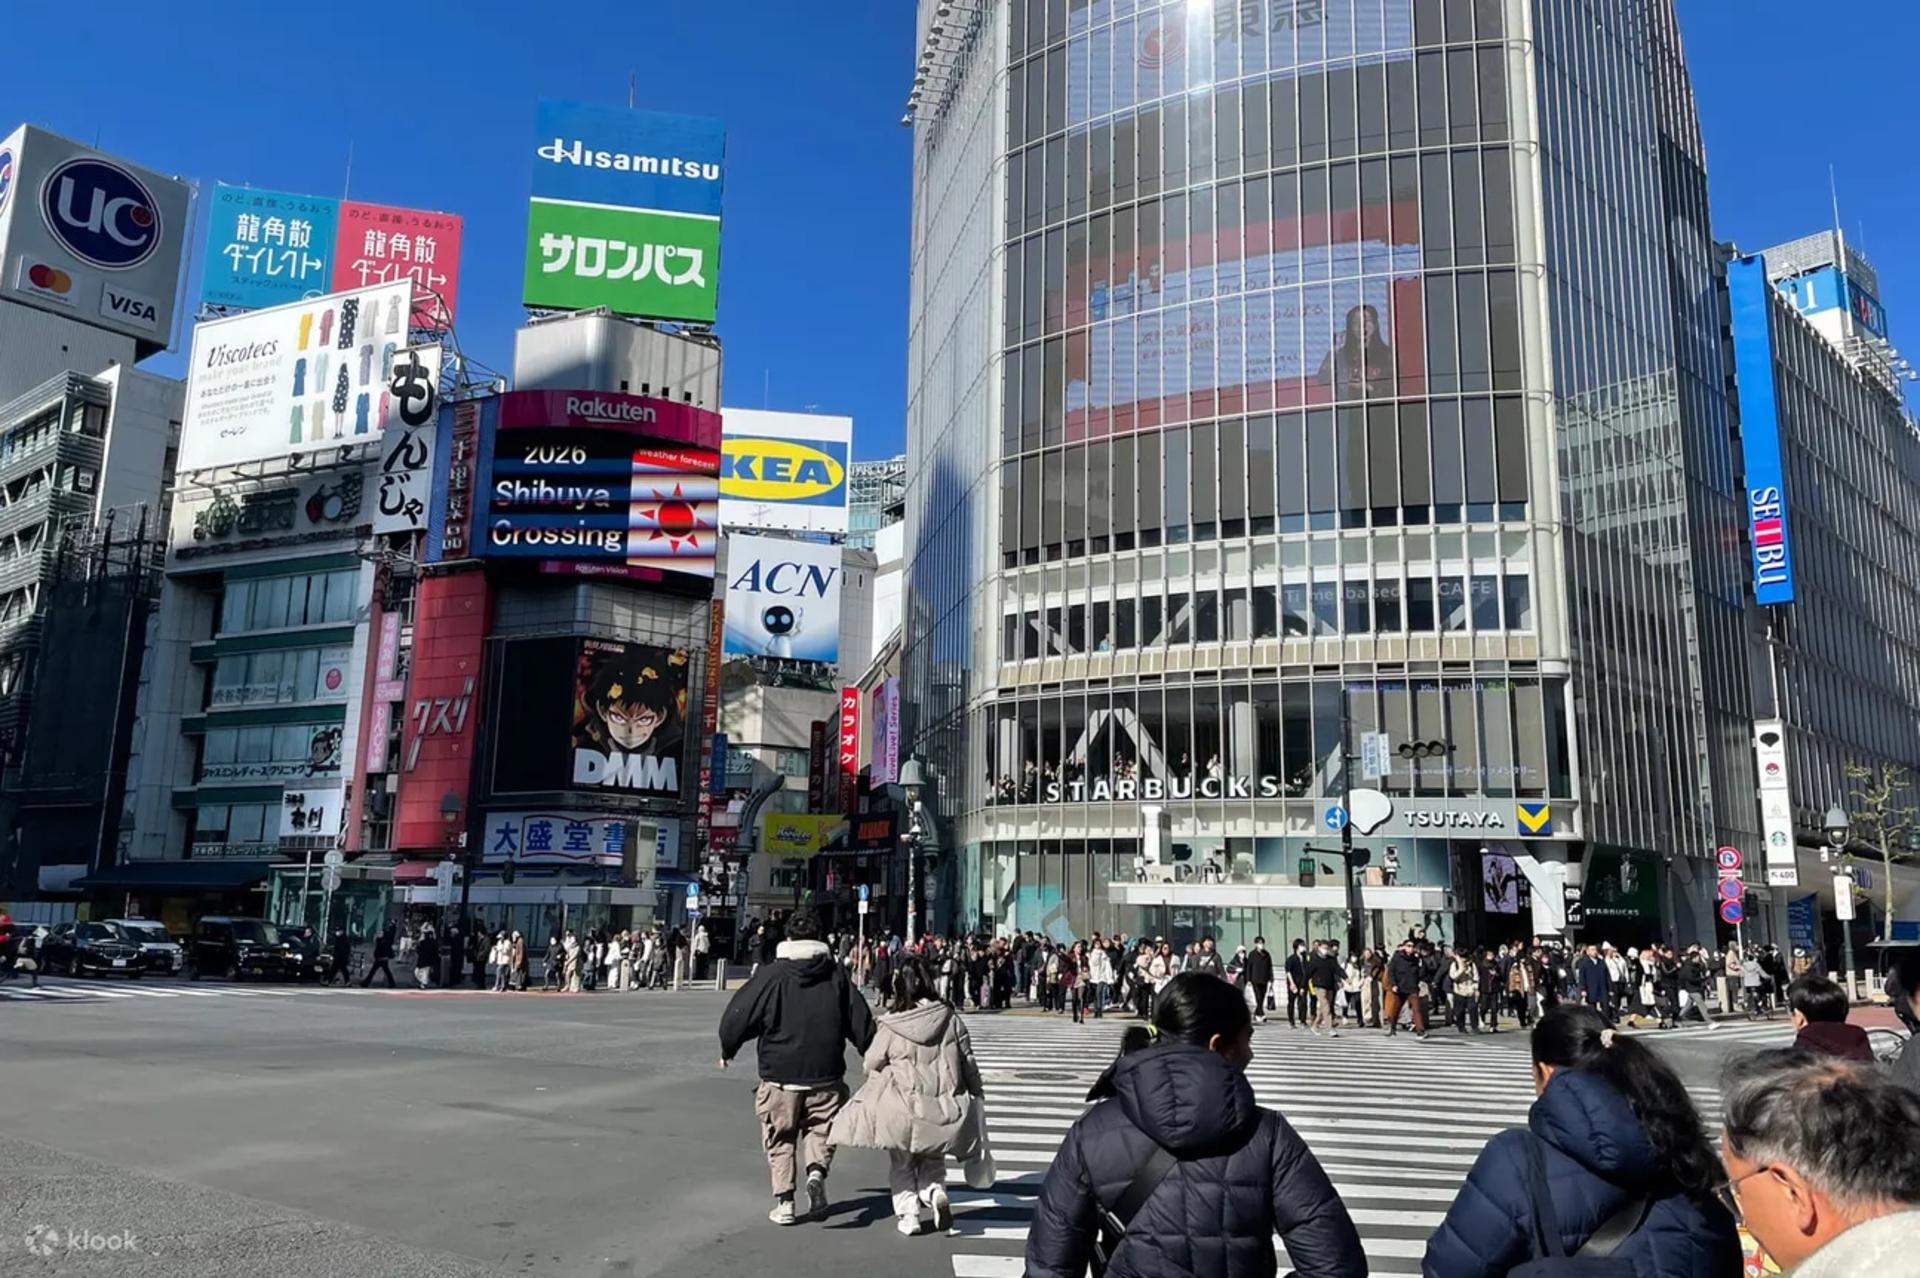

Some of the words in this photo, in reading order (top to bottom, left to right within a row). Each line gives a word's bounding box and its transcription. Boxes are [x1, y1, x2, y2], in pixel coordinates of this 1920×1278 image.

[537, 138, 719, 180] Hisamitsu
[236, 213, 313, 249] 龍角散
[363, 229, 437, 264] 龍角散
[223, 243, 322, 280] ダイレクト
[539, 232, 705, 288] サロンパス
[107, 292, 156, 321] VISA
[207, 339, 279, 368] Viscotecs
[566, 397, 656, 423] Rakuten
[378, 351, 434, 525] もんじゃ
[524, 445, 587, 465] 2026
[680, 454, 716, 470] forecast
[720, 453, 832, 485] KEA
[495, 479, 610, 510] Shibuya
[492, 519, 623, 552] Crossing
[1751, 486, 1788, 586] SEIBU
[730, 558, 838, 598] ACN
[1439, 580, 1491, 596] CAFE
[841, 696, 856, 765] カラオケ
[573, 748, 678, 792] DMM
[1047, 775, 1278, 803] STARBUCKS
[1404, 811, 1504, 828] TSUTAYA
[1585, 908, 1640, 917] STARBUCKS
